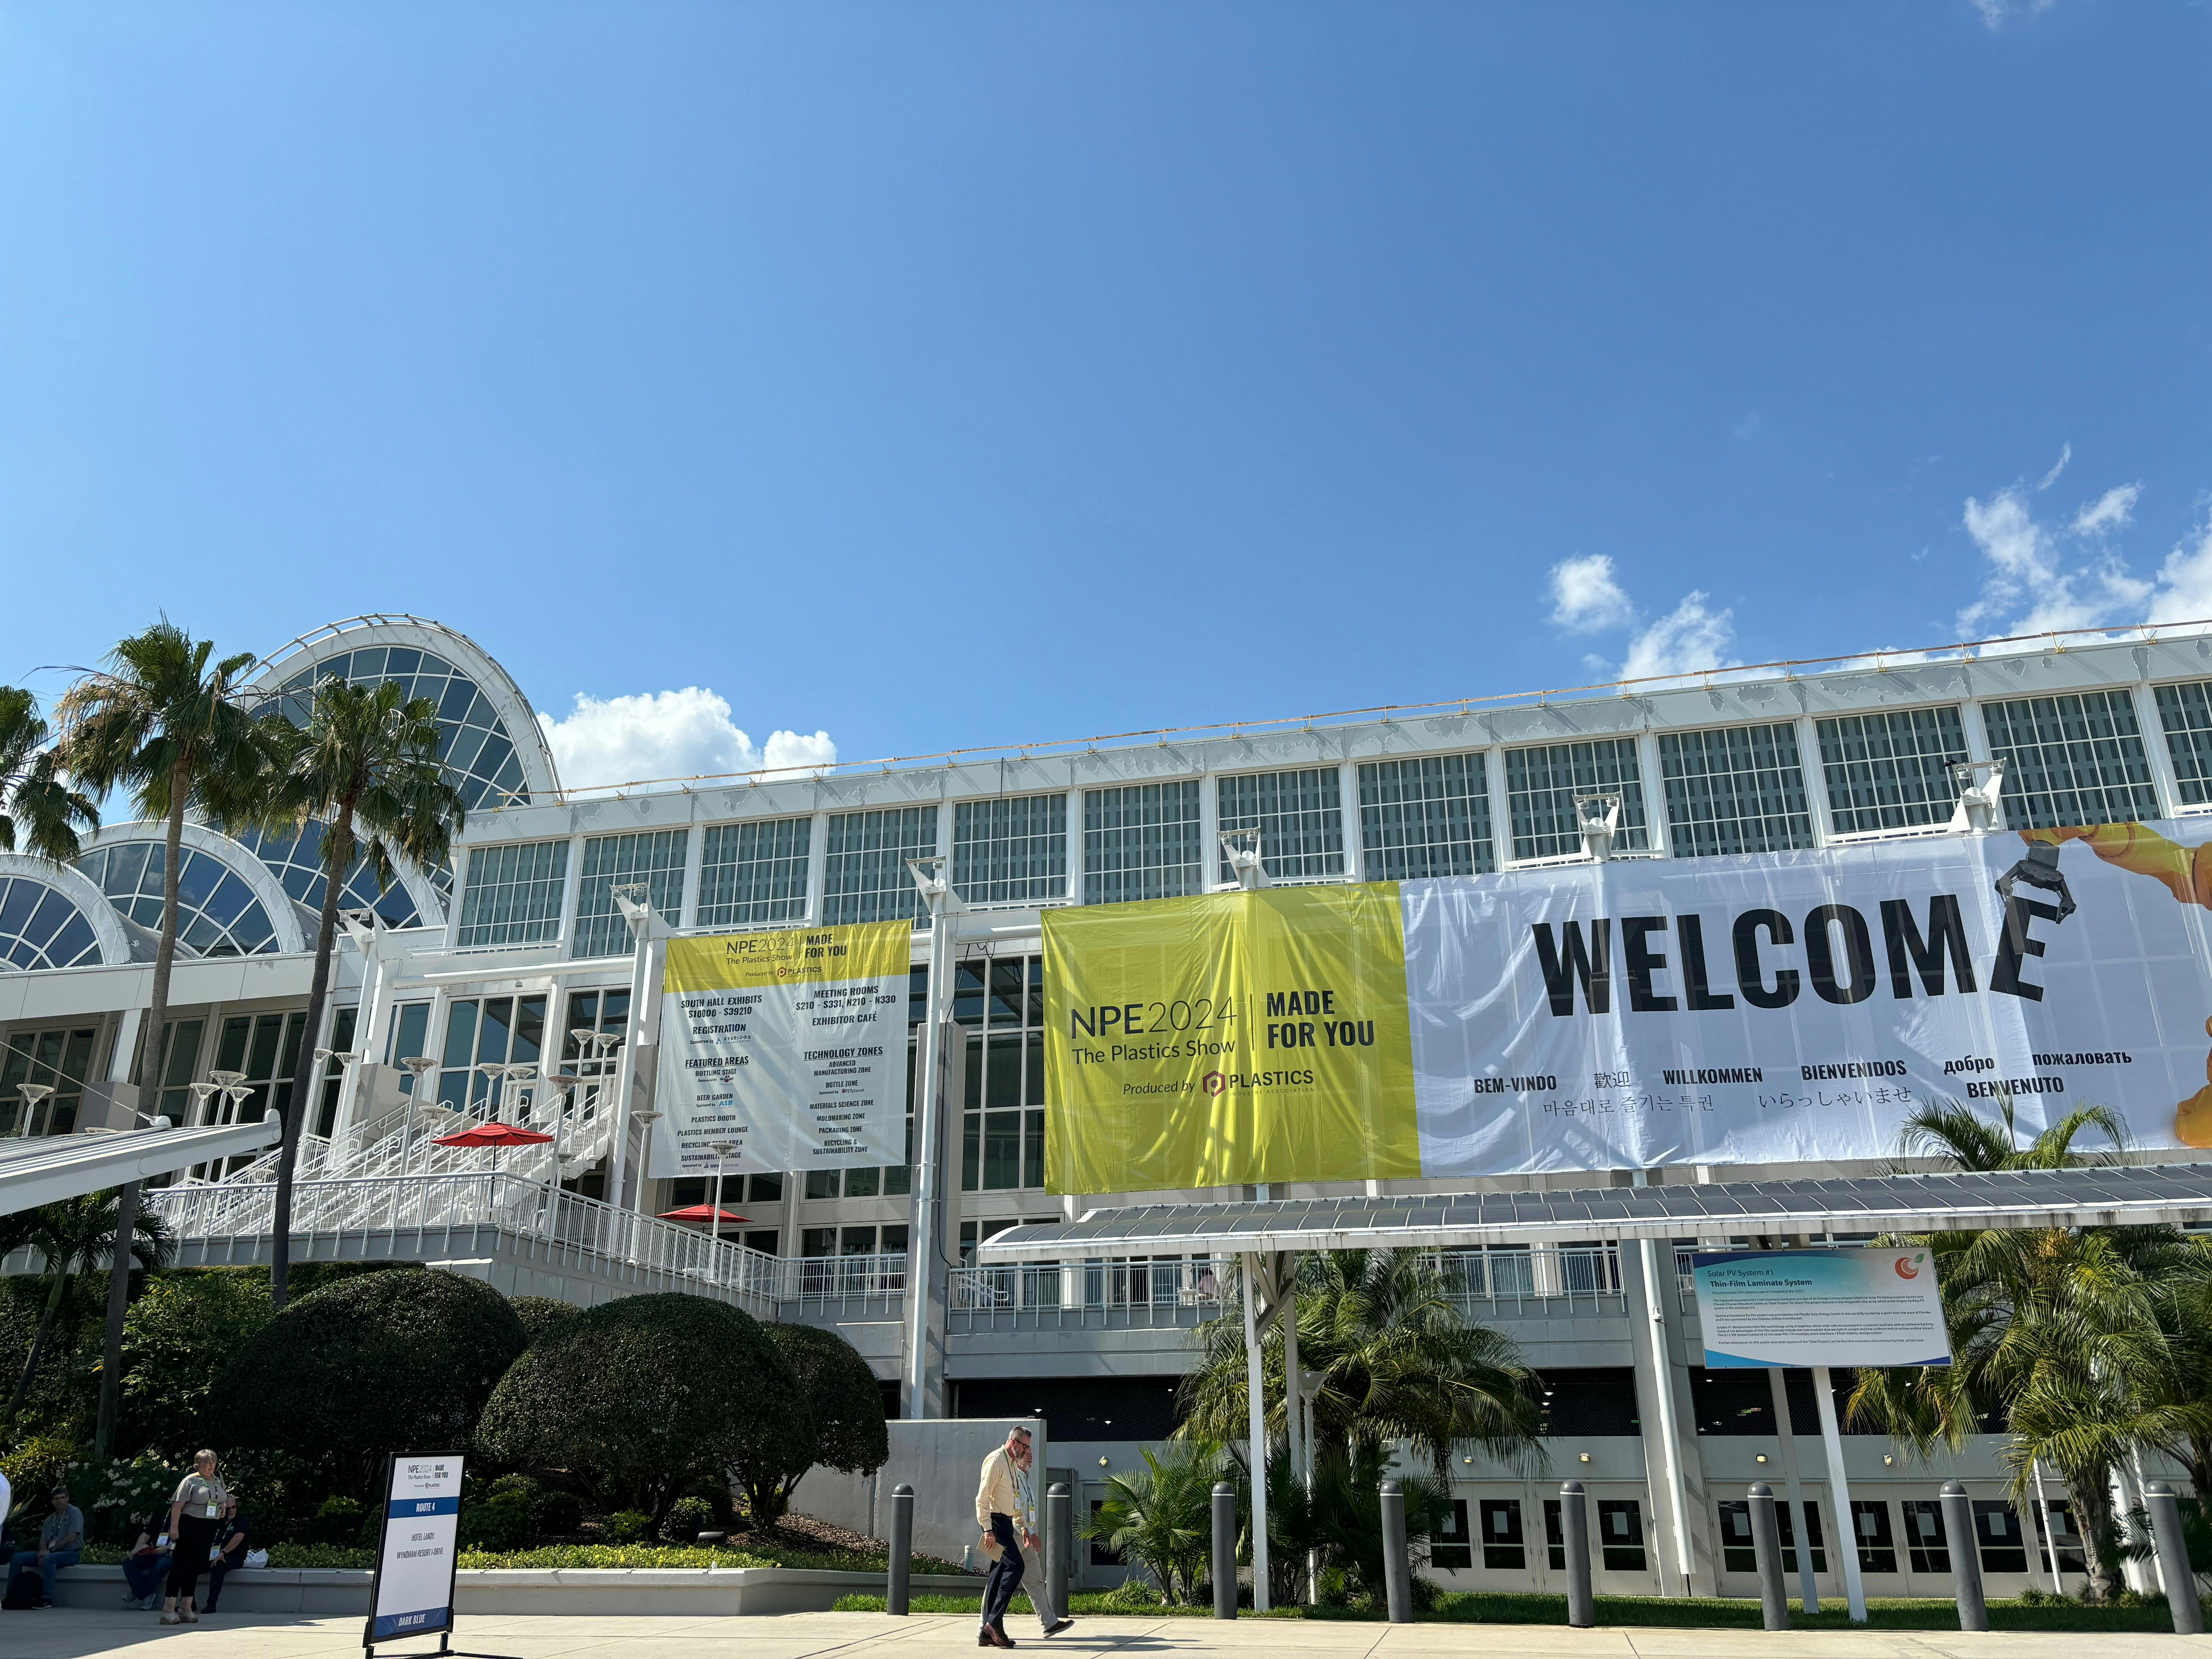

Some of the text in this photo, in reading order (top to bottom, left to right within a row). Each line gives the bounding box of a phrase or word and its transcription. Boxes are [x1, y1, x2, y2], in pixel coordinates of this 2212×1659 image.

[726, 937, 795, 954] NPE2024
[806, 934, 833, 945] MADE
[742, 955, 770, 963] Plastics
[805, 945, 847, 958] FOR YOU
[1532, 894, 2060, 1017] WELCOME
[788, 967, 822, 975] PLASTICS
[814, 986, 878, 998] MEETING ROOMS
[681, 995, 762, 1008] SOUTH HALL EXHIBITS
[796, 1001, 814, 1010] S210
[823, 1000, 844, 1008] S331,
[847, 997, 866, 1007] N210
[875, 995, 896, 1004] N330
[1266, 990, 1335, 1017] MADE
[689, 1009, 716, 1018] S10000
[724, 1006, 752, 1016] S39210
[812, 1011, 877, 1026] EXHIBITOR CAFÉ
[1071, 996, 1238, 1039] NPE2024
[693, 1024, 746, 1035] REGISTRATION
[1268, 1019, 1375, 1049] FOR YOU
[804, 1046, 883, 1060] TECHNOLOGY ZONES
[1072, 1039, 1236, 1065] The Plastics Show
[685, 1056, 749, 1068] FEATURED AREAS
[1944, 1051, 2132, 1075] добро пожаловать
[814, 1068, 857, 1076] MANUFACTURING
[1662, 1068, 1763, 1085] WILLKOMMEN
[1801, 1060, 1907, 1080] BIENVENIDOS
[1230, 1070, 1314, 1089] PLASTICS
[1474, 1075, 1557, 1094] BEM-VINDO
[1594, 1071, 1630, 1089] 歡迎
[1123, 1080, 1195, 1095] Produced by
[1966, 1077, 2064, 1098] BENVENUTO
[1759, 1087, 1912, 1108] いらっしゃいませ
[1542, 1094, 1714, 1117] 마음대로 즐기는 특권
[1738, 1269, 1764, 1278] System
[408, 1465, 432, 1473] NPE2024
[416, 1502, 435, 1512] ROUTE 4
[411, 1532, 434, 1541] HOTEL LANDY
[397, 1547, 443, 1559] WYNDHAM RESORT I-DRIVE
[398, 1614, 426, 1626] DARK BLUE
